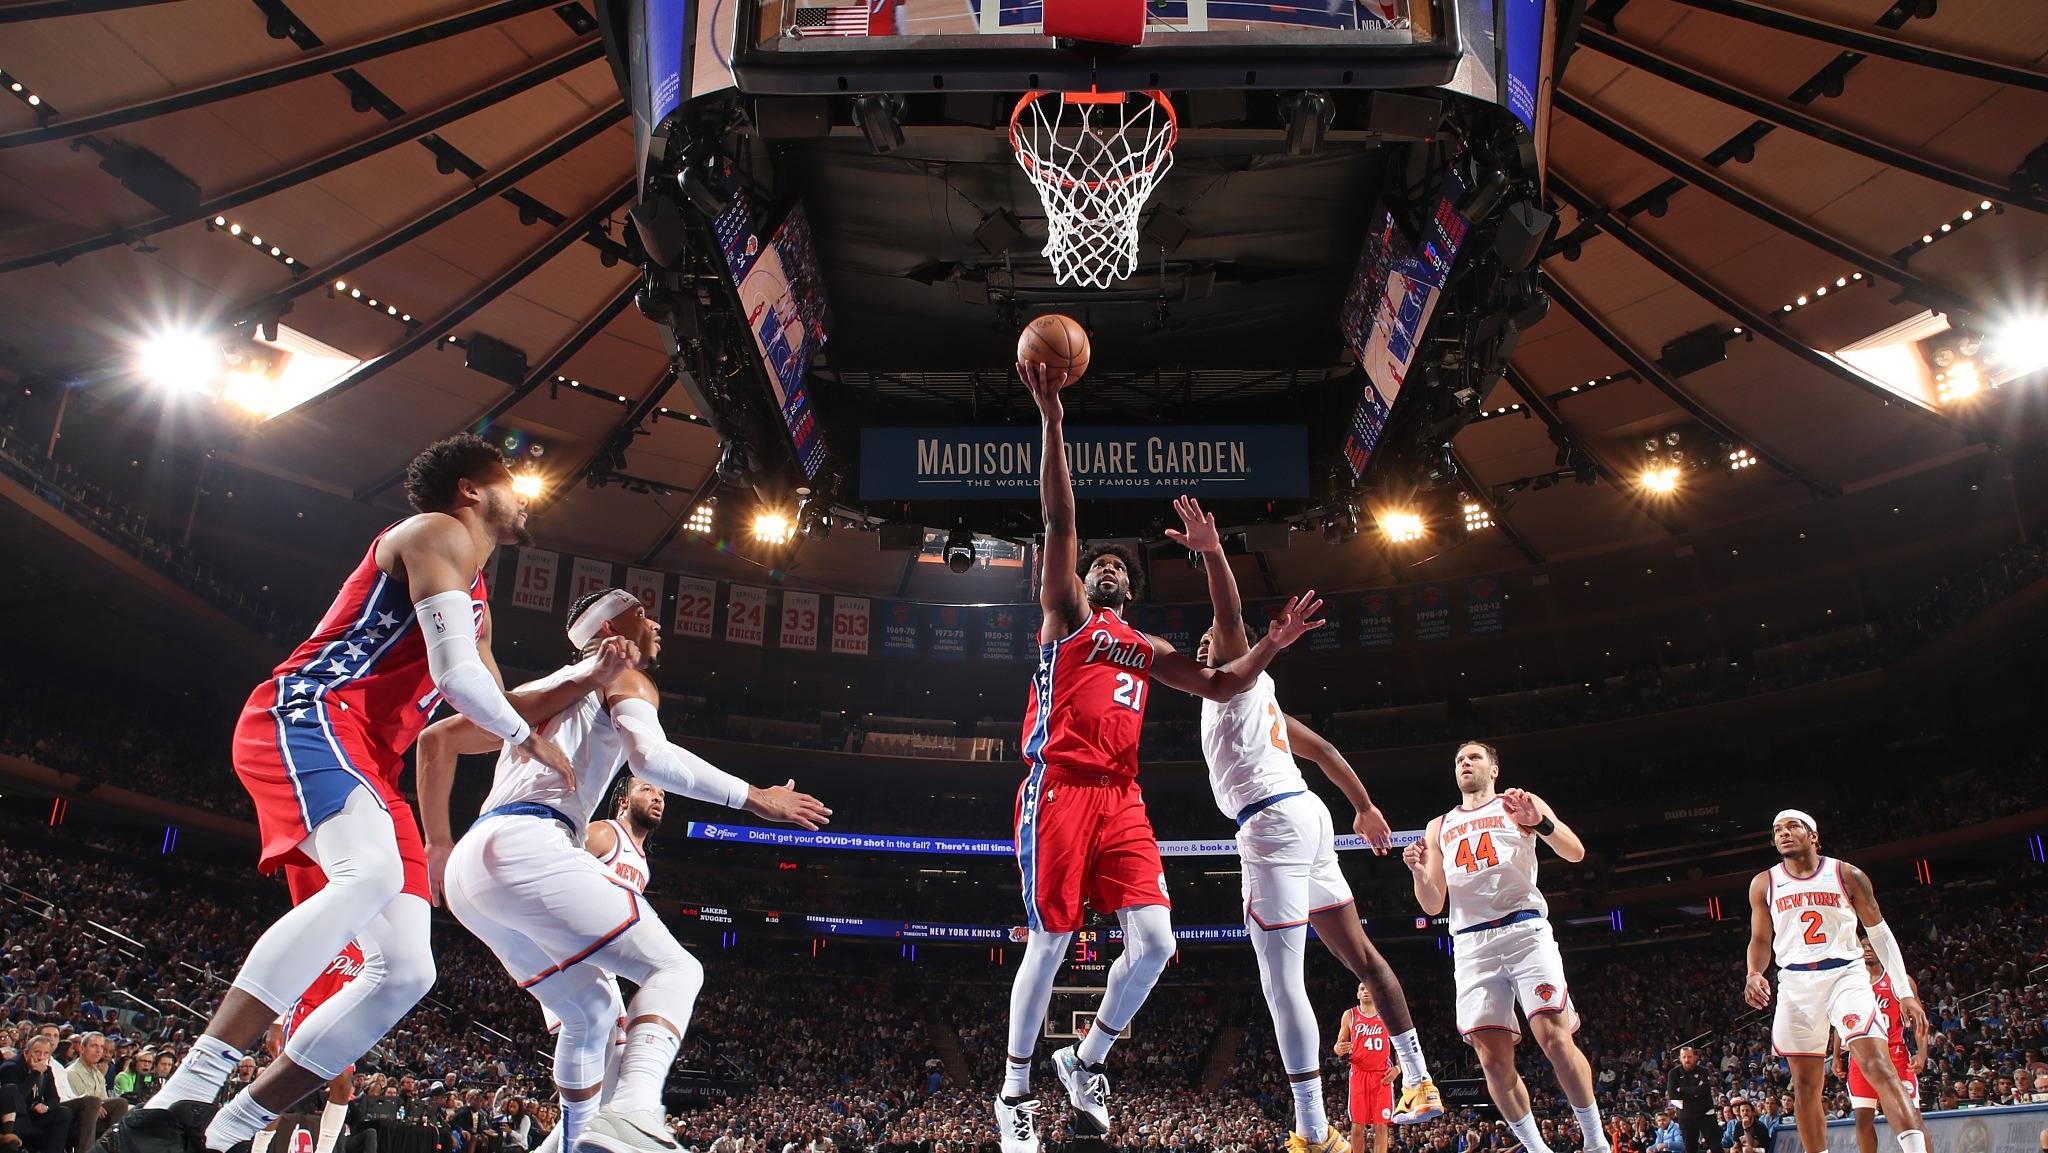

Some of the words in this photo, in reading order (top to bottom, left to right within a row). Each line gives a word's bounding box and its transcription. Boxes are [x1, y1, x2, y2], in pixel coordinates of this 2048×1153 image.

[1361, 19, 1382, 31] NBA
[918, 439, 1031, 475] MADISON
[967, 479, 991, 487] THE
[996, 479, 1040, 487] WORLD
[1100, 478, 1149, 486] FAMOUS
[522, 566, 550, 591] 15
[515, 592, 552, 608] KNICKS
[680, 594, 712, 619] 22
[731, 602, 761, 627] 24
[785, 608, 816, 632] 33
[676, 620, 712, 634] KNICKS
[834, 613, 868, 636] 613
[729, 628, 762, 642] KNICKS
[782, 634, 816, 646] KNICKS
[834, 639, 867, 650] KNICKS
[1085, 629, 1146, 669] Phila
[1113, 671, 1144, 713] 21
[1688, 805, 1720, 817] LIGHT
[717, 828, 738, 840] Pfizer
[1443, 821, 1469, 843] NEW
[1470, 816, 1506, 831] YORK
[749, 830, 776, 840] Didn't
[778, 832, 793, 843] get
[794, 835, 814, 845] your
[815, 835, 862, 846] COVID-19
[863, 838, 885, 848] shot
[886, 839, 895, 848] in
[896, 840, 911, 849] the
[912, 841, 931, 850] fall?
[935, 841, 969, 851] There's
[971, 843, 990, 852] still
[991, 843, 1015, 852] time.
[1191, 844, 1198, 852] &
[1455, 831, 1500, 874] 44
[1775, 893, 1803, 913] NEW
[1804, 891, 1841, 908] YORK
[701, 907, 728, 915] LAKERS
[700, 915, 732, 924] NUGGETS
[830, 924, 837, 932] 7
[930, 927, 946, 936] NEW
[948, 928, 970, 937] YORK
[971, 928, 1001, 938] KNICKS
[1109, 930, 1123, 939] 32
[1221, 929, 1248, 938] 76ERS
[1800, 910, 1827, 945] 2
[325, 954, 365, 977] Phil
[1355, 1023, 1383, 1040] Phila
[1363, 1037, 1383, 1051] 40
[700, 1087, 727, 1097] ULTRA
